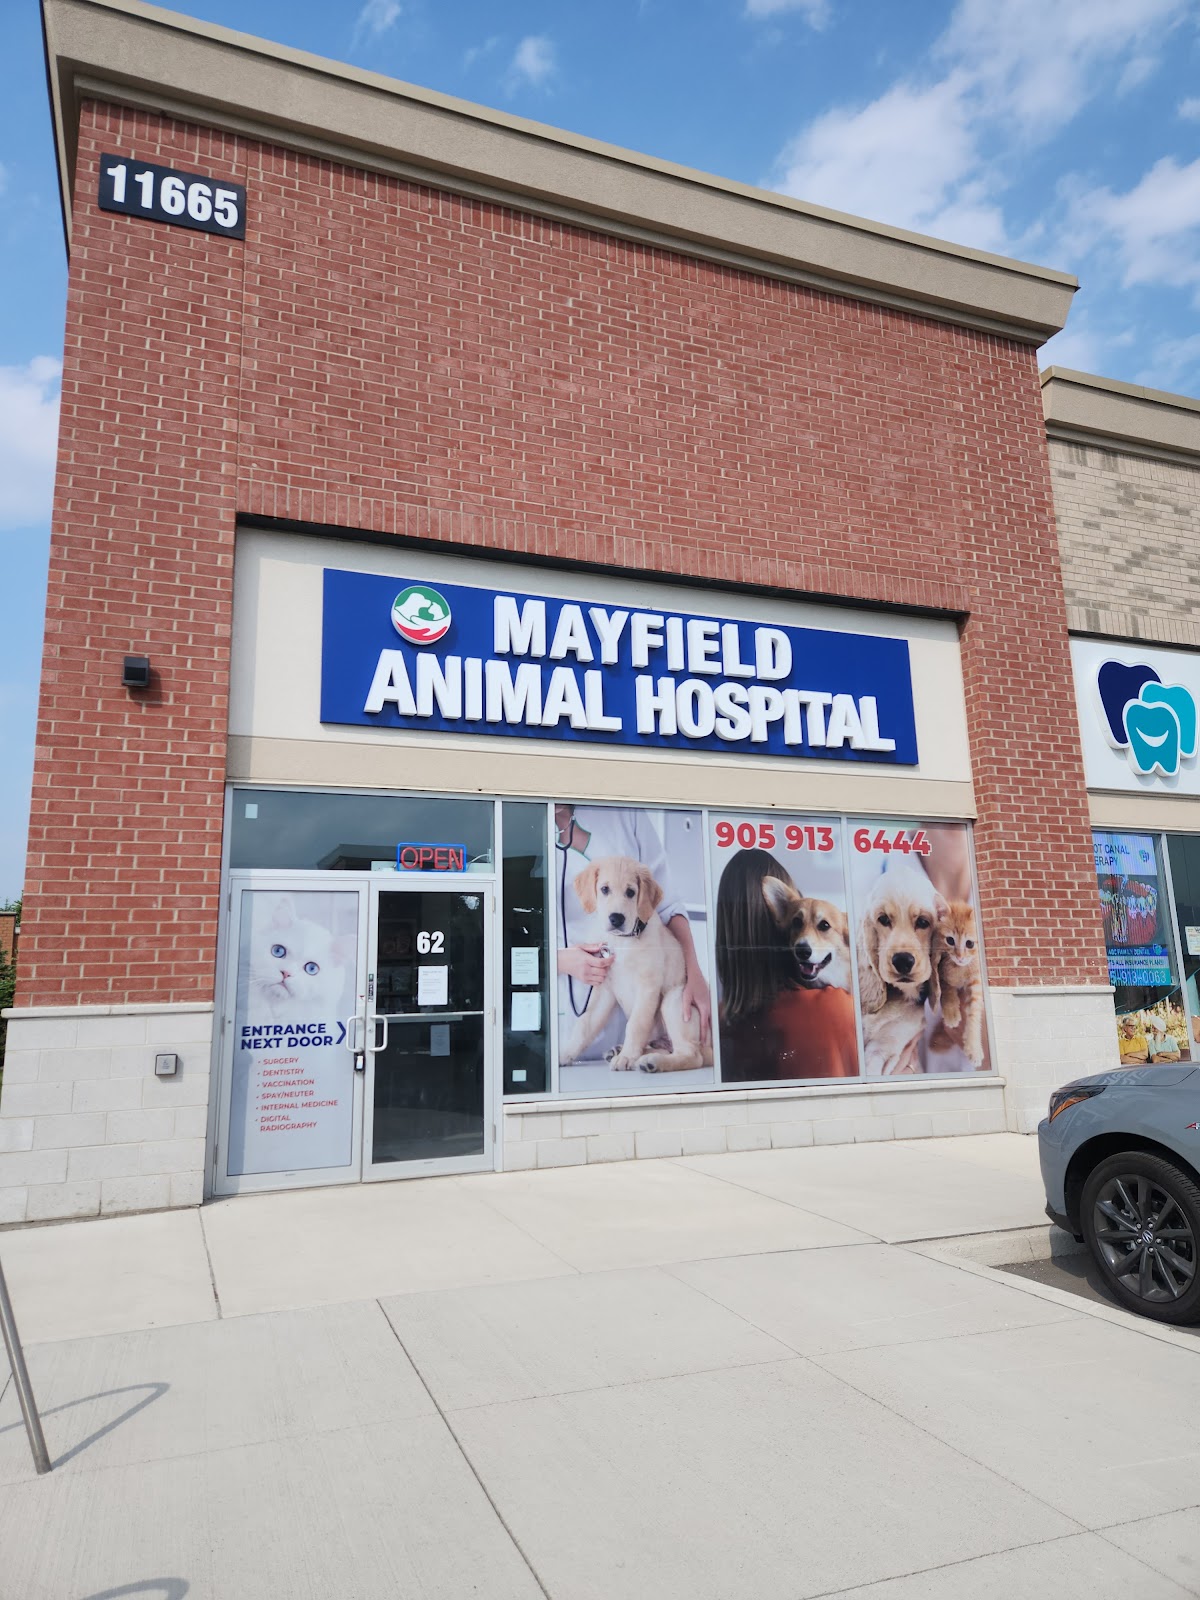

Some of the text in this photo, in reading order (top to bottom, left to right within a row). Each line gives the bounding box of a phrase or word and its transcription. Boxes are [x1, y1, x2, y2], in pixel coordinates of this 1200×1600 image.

[106, 163, 239, 229] 11665
[493, 595, 793, 680] MAYFIELD
[363, 648, 896, 752] ANIMAL HOSPITAL
[715, 821, 932, 855] 905 913 6444
[1104, 844, 1130, 855] CANAL
[401, 847, 463, 869] OPEN
[416, 931, 445, 954] 62
[241, 1024, 326, 1036] ENTRANCE
[241, 1036, 333, 1050] NEXT DOOR
[263, 1057, 299, 1065] SURGERY
[262, 1068, 305, 1077] DENTISTRY
[262, 1079, 315, 1088] VACCINATION
[261, 1090, 314, 1100] SPAY/NEUTER
[261, 1100, 338, 1111] INTERNAL MEDICINE
[260, 1115, 291, 1123] DIGITAL
[260, 1122, 317, 1132] RADIOGRAPHY
